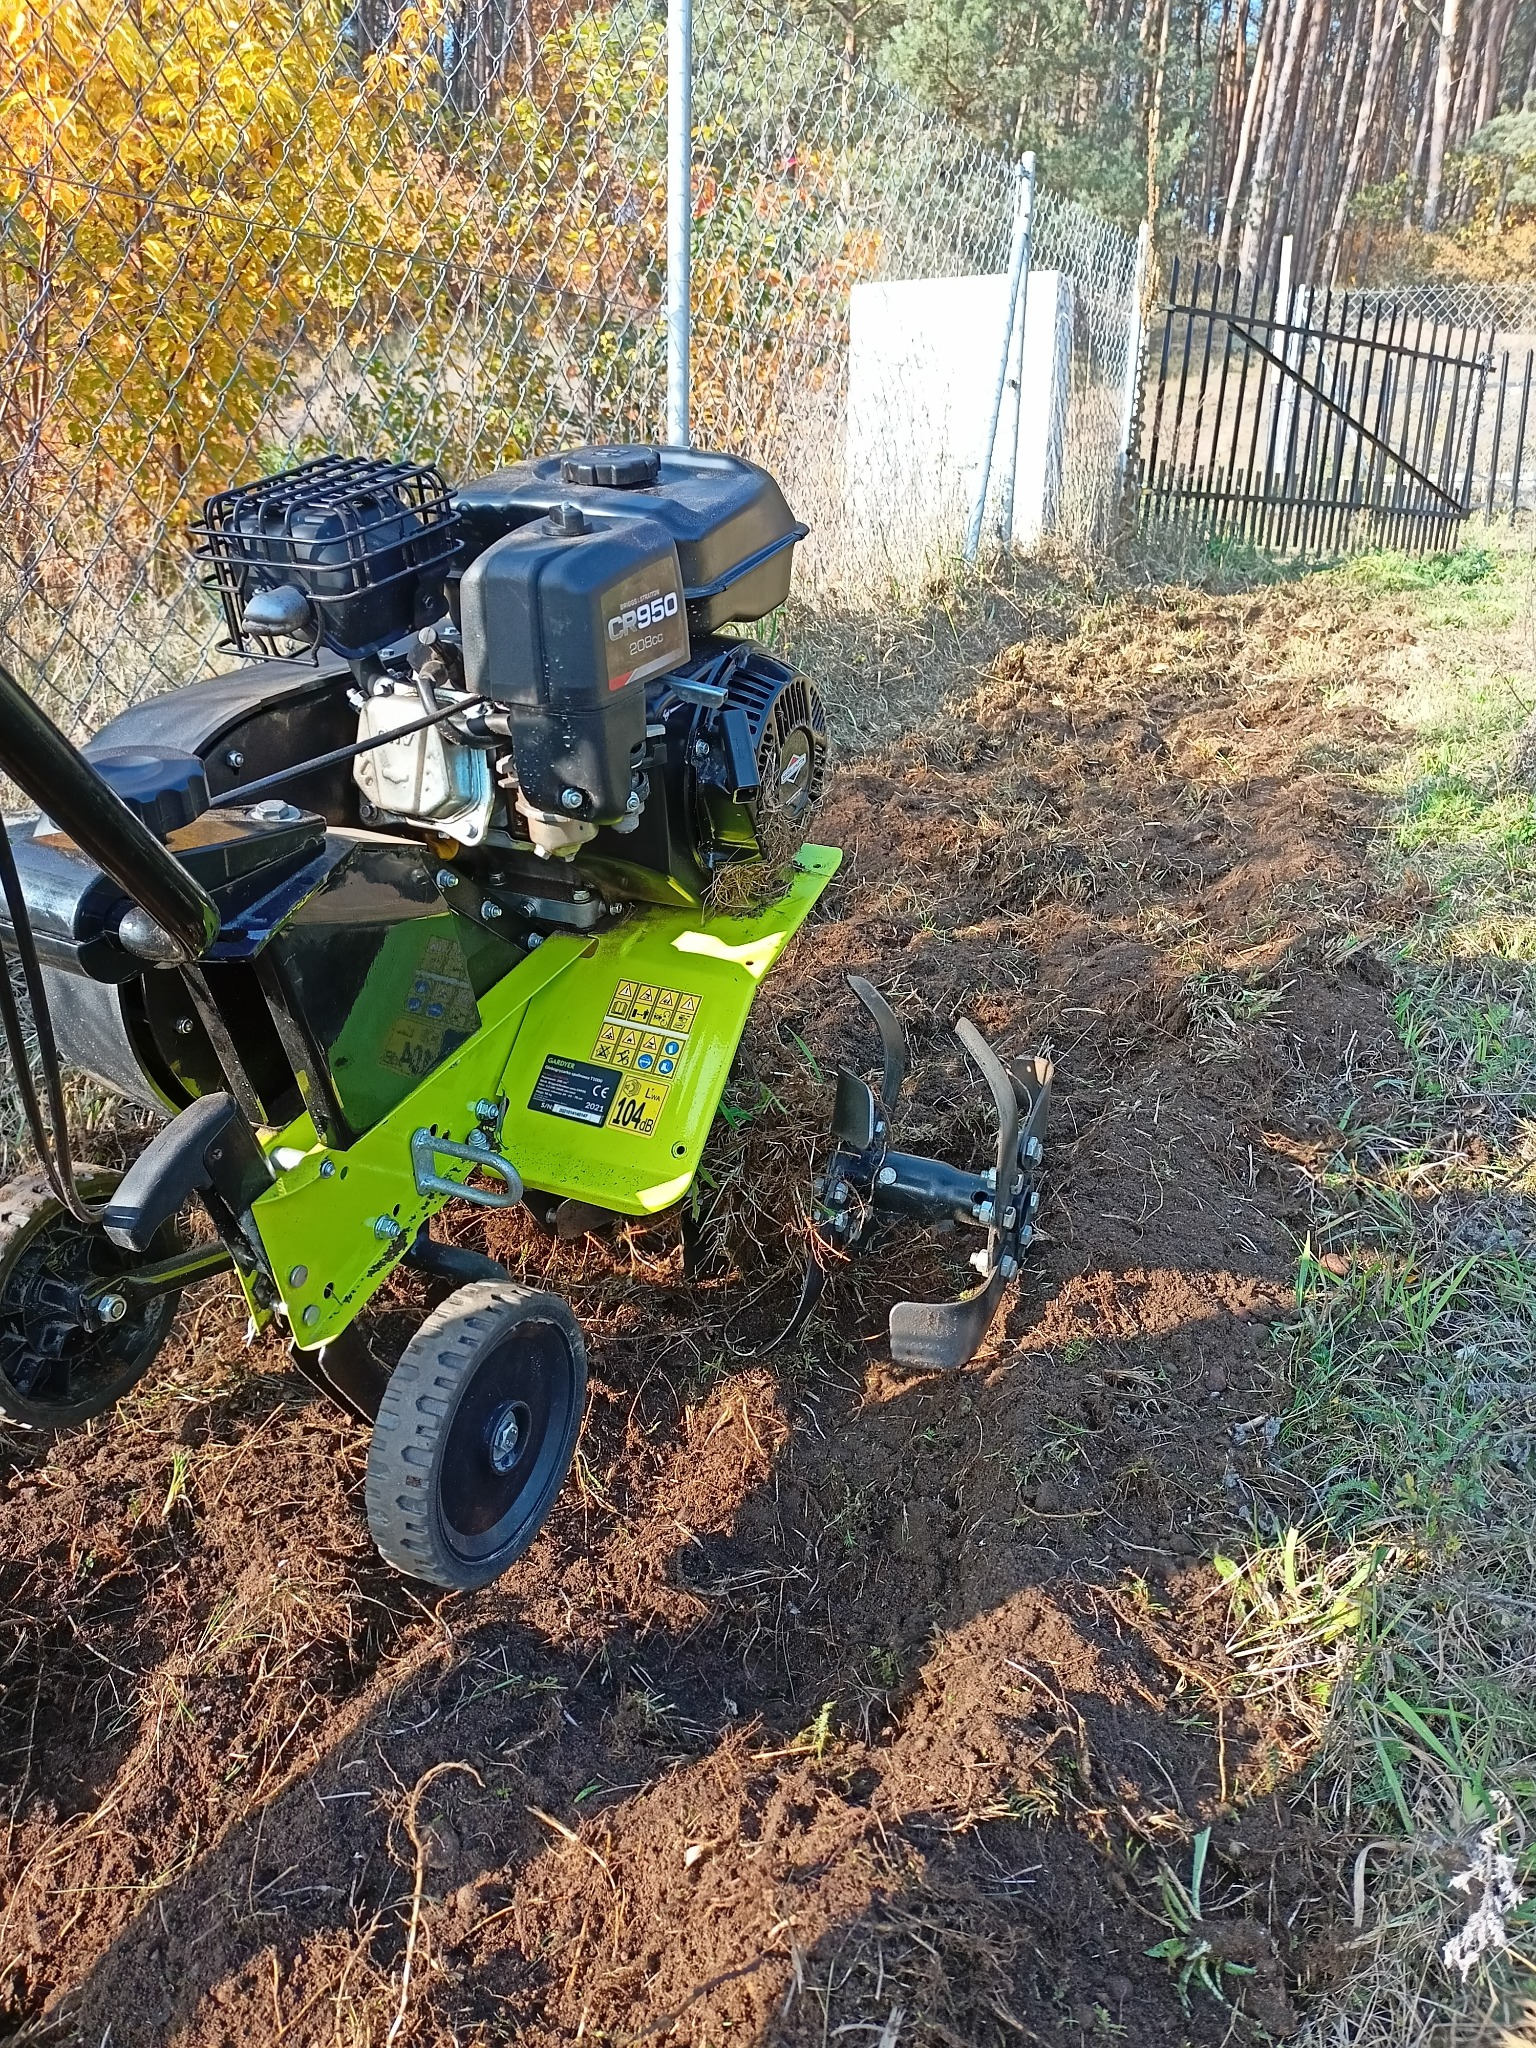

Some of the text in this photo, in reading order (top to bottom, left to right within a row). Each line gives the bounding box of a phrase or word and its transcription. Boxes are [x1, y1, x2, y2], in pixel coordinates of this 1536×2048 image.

[608, 591, 678, 642] CR950
[629, 633, 664, 656] 208cc
[547, 1057, 576, 1069] GARDYER
[584, 1101, 604, 1113] 2021
